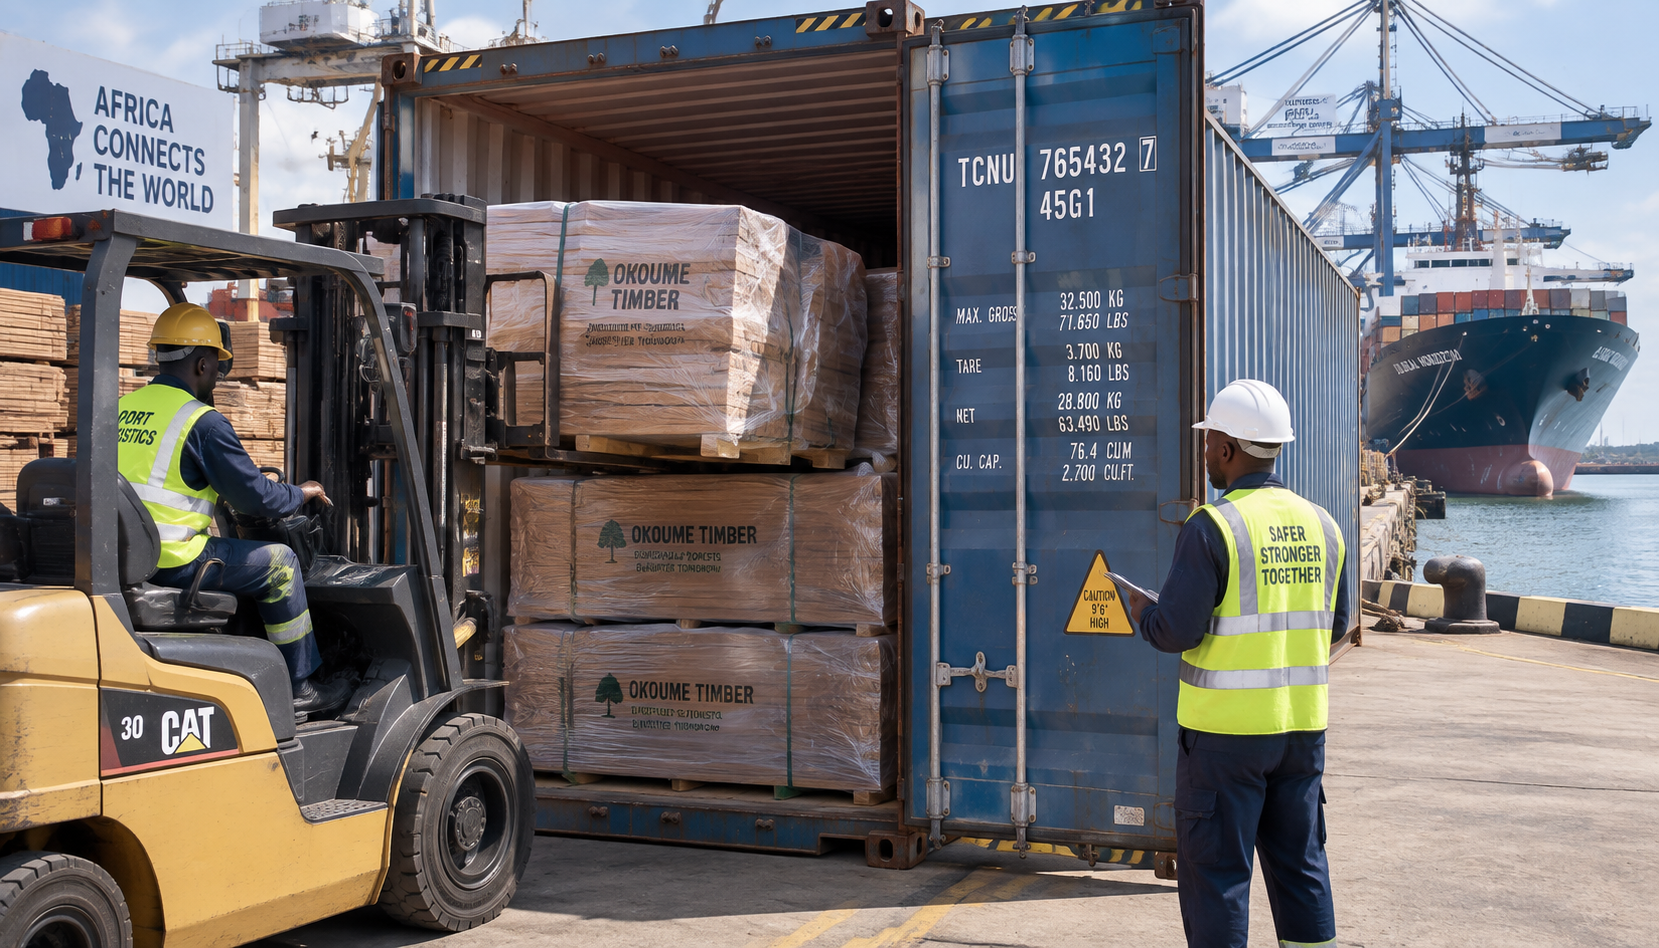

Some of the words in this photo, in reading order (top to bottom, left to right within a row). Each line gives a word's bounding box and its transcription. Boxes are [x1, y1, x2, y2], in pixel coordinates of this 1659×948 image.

[94, 85, 174, 133] AFRICA
[94, 124, 206, 176] CONNECTS
[958, 153, 1015, 187] TCNU
[1039, 142, 1126, 180] 765432
[1141, 139, 1154, 169] 7
[93, 163, 135, 201] THE
[142, 173, 214, 214] WORLD
[1039, 187, 1094, 220] 45G1
[613, 262, 691, 285] OKOUME
[611, 289, 680, 310] TIMBER
[1060, 290, 1101, 311] 32.500
[1108, 289, 1124, 308] KG
[956, 308, 982, 324] MAX.
[1059, 312, 1100, 331] 71.650
[1106, 311, 1129, 329] LBS
[1066, 342, 1100, 360] 3.700
[1106, 341, 1122, 359] KG
[956, 358, 982, 374] TARE
[1068, 363, 1101, 382] 8.160
[1108, 363, 1130, 381] LBS
[1058, 391, 1099, 411] 28.800
[1106, 391, 1122, 410] KG
[956, 408, 975, 424] NET
[1058, 414, 1100, 432] 63.490
[1106, 414, 1129, 432] LBS
[1070, 441, 1098, 460] 76.4
[956, 455, 973, 470] CU.
[978, 454, 1002, 470] CAP.
[1062, 463, 1096, 482] 2.700
[631, 525, 694, 544] OKOUME
[699, 525, 757, 544] TIMBER
[1268, 525, 1307, 542] SAFER
[1260, 545, 1322, 565] STRONGER
[1261, 566, 1322, 586] TOGETHER
[1083, 589, 1116, 602] CAUTION
[1090, 616, 1110, 629] HIGH
[629, 680, 691, 701] OKOUME
[695, 683, 754, 704] TIMBER
[121, 714, 144, 741] 30
[161, 706, 215, 756] CAT
